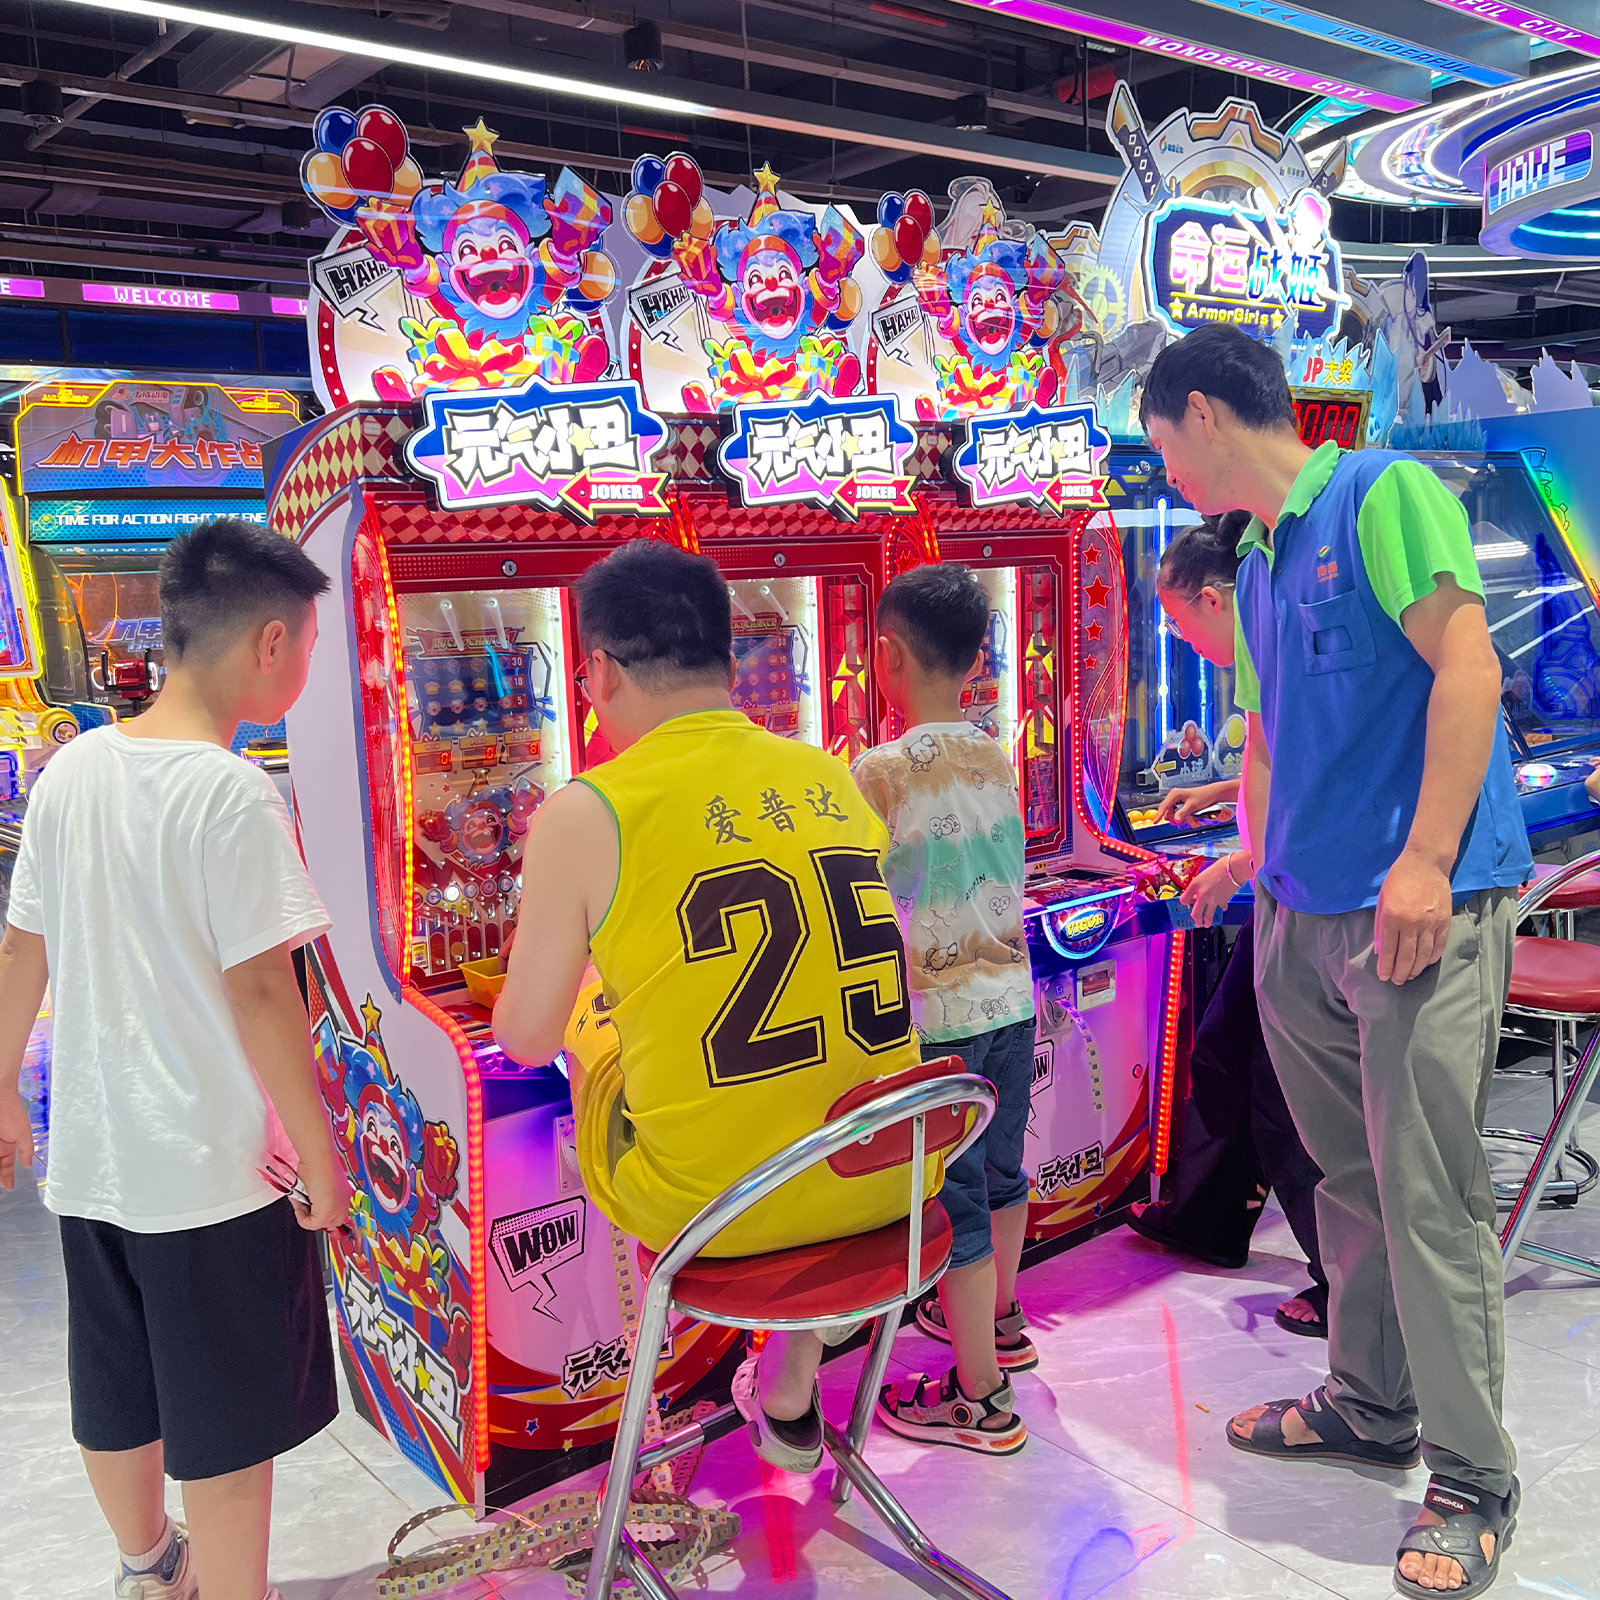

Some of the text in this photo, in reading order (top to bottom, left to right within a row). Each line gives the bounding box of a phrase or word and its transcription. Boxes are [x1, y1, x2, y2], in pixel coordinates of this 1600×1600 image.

[1519, 19, 1582, 41] CITY
[1328, 27, 1471, 73] WONDERFUL
[1138, 35, 1373, 100] WONDERFUL CITY
[1497, 138, 1567, 207] HAVE
[113, 286, 211, 308] WELCOME
[1186, 301, 1269, 326] ArmorGirls
[1302, 356, 1354, 386] JP大奖
[1291, 402, 1360, 447] 000
[445, 400, 638, 487] 元气小丑
[750, 412, 895, 489] 元气小丑
[978, 419, 1092, 488] 元气小丑
[589, 484, 645, 501] JOKER
[855, 484, 898, 500] JOKER
[1060, 484, 1094, 498] JOKER
[56, 514, 90, 526] TIME
[92, 514, 119, 525] FOR
[122, 514, 174, 525] ACTION
[174, 513, 213, 524] FIGHT
[511, 657, 523, 667] 30
[779, 655, 787, 664] 10
[984, 652, 989, 660] 5
[514, 677, 523, 686] 10
[781, 673, 786, 681] 5
[517, 696, 523, 706] 5
[518, 715, 524, 725] 3
[789, 713, 796, 725] 2
[510, 733, 534, 741] CREDIT
[425, 743, 440, 751] WIN
[486, 746, 495, 760] 0
[529, 741, 538, 755] 8
[440, 751, 449, 766] 0
[704, 782, 849, 846] 爱普达
[1066, 912, 1104, 939] VIGOR
[676, 845, 914, 1089] 25
[502, 1213, 576, 1273] WOW
[345, 1268, 460, 1449] 元气小丑
[1432, 1495, 1464, 1510] XINGHUA
